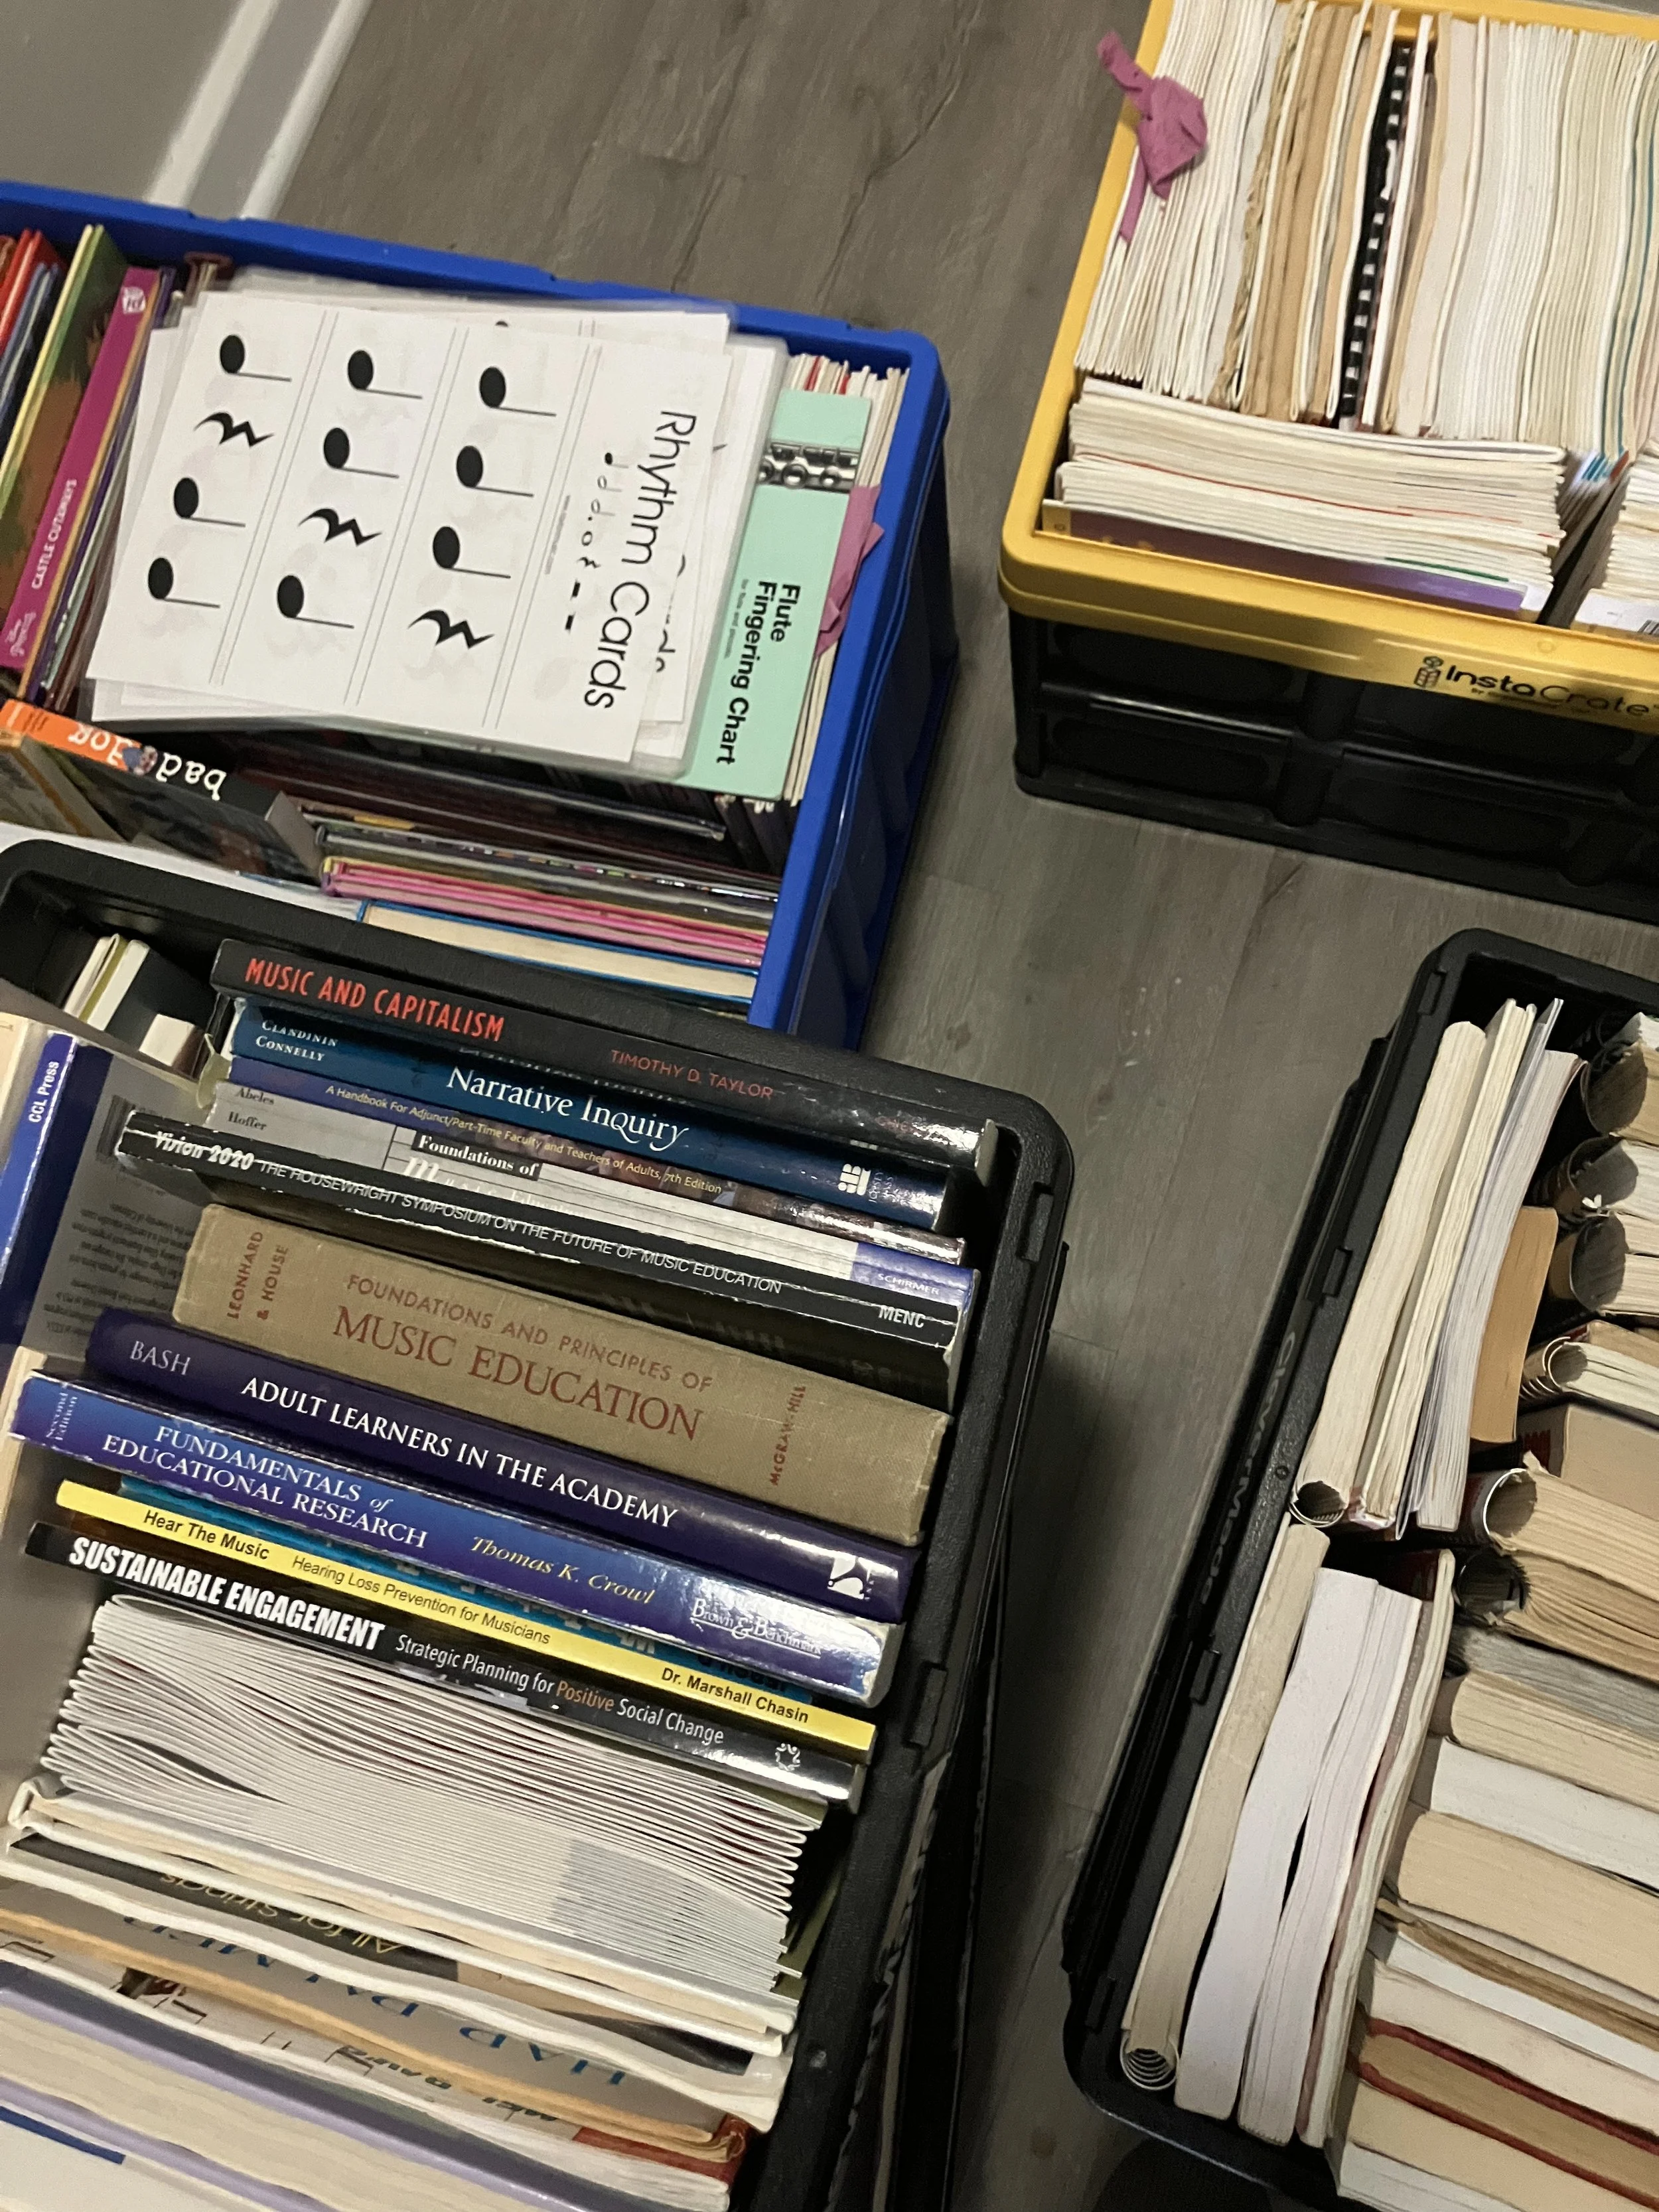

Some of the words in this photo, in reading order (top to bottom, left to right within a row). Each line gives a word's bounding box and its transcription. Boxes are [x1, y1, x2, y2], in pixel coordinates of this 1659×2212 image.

[620, 410, 697, 565] Rhythm
[584, 581, 649, 709] Cards
[730, 581, 777, 690] Fingering
[770, 583, 801, 642] Flute
[1445, 664, 1650, 716] InstaCrate
[716, 697, 750, 765] Chart
[155, 752, 228, 802] bad
[245, 958, 315, 996] MUSIC
[318, 976, 366, 1009] AND
[374, 989, 506, 1043] CAPITALISM
[261, 1019, 339, 1047] CLANDININ
[255, 1035, 326, 1063] CONNELLY
[611, 1049, 683, 1079] TIMOTHY
[687, 1069, 701, 1084] D.
[709, 1072, 774, 1100] TAYLOR
[28, 1098, 45, 1124] CCL
[38, 1061, 60, 1096] Press
[227, 1111, 268, 1131] Hoffer
[236, 1087, 275, 1106] Abeles
[446, 1065, 575, 1117] Narrative
[581, 1096, 690, 1151] Inquiry
[325, 1085, 336, 1095] A
[337, 1087, 388, 1108] Handbook
[390, 1100, 409, 1115] For
[408, 1105, 503, 1140] Adjunct/Part-Time
[504, 1128, 542, 1150] Faculty
[543, 1138, 565, 1153] and
[566, 1143, 611, 1166] Teachers
[613, 1157, 624, 1169] of
[625, 1160, 662, 1181] Adults,
[665, 1170, 684, 1185] 7th
[684, 1174, 723, 1195] Edition
[416, 1134, 515, 1172] Foundations
[519, 1157, 541, 1179] of
[207, 1144, 255, 1171] 2020
[259, 1159, 288, 1179] THE
[290, 1166, 399, 1205] HOUSEWRIGHT
[401, 1195, 494, 1226] SYMPOSIUM
[493, 1216, 518, 1232] ON
[521, 1221, 551, 1242] THE
[552, 1228, 613, 1255] FUTURE
[615, 1241, 640, 1260] OF
[640, 1250, 691, 1274] MUSIC
[692, 1262, 783, 1295] EDUCATION
[226, 1230, 264, 1321] LEONHARD
[261, 1245, 289, 1303] HOUSE
[876, 1272, 941, 1297] SCHIRMER
[256, 1309, 269, 1321] &
[346, 1274, 494, 1329] FOUNDATIONS
[501, 1321, 549, 1345] AND
[559, 1337, 672, 1382] PRINCIPLES
[684, 1370, 713, 1392] OF
[877, 1303, 926, 1329] MENC
[129, 1339, 191, 1376] BASH
[332, 1305, 458, 1367] MUSIC
[467, 1344, 705, 1442] EDUCATION
[154, 1425, 362, 1503] FUNDAMENTALS
[370, 1496, 394, 1514] of
[241, 1376, 328, 1418] ADULT
[329, 1402, 455, 1458] LEARNERS
[457, 1442, 490, 1469] IN
[496, 1456, 547, 1487] THE
[549, 1472, 679, 1528] ACADEMY
[769, 1384, 807, 1487] McGRAW-HILL
[102, 1436, 285, 1507] EDUCATIONAL
[292, 1493, 430, 1550] RESEARCH
[68, 1535, 224, 1607] SUSTAINABLE
[224, 1580, 386, 1652] ENGAGEMENT
[143, 1509, 185, 1536] Hear
[188, 1522, 218, 1546] The
[220, 1532, 270, 1561] Music
[292, 1554, 346, 1585] Hearing
[347, 1572, 380, 1593] Loss
[384, 1582, 457, 1617] Prevention
[460, 1605, 480, 1622] for
[481, 1612, 551, 1647] Musicians
[470, 1535, 555, 1575] Thomas
[557, 1562, 589, 1584] K.
[588, 1572, 658, 1607] Crowl
[691, 1598, 734, 1627] Brown
[732, 1617, 754, 1640] &
[396, 1633, 461, 1669] Strategic
[463, 1653, 530, 1693] Planning
[532, 1670, 555, 1695] for
[555, 1680, 615, 1714] Positive
[616, 1697, 664, 1728] Social
[665, 1711, 725, 1747] Change
[661, 1666, 682, 1686] Dr.
[685, 1674, 753, 1704] Marshall
[755, 1694, 810, 1725] Chasin
